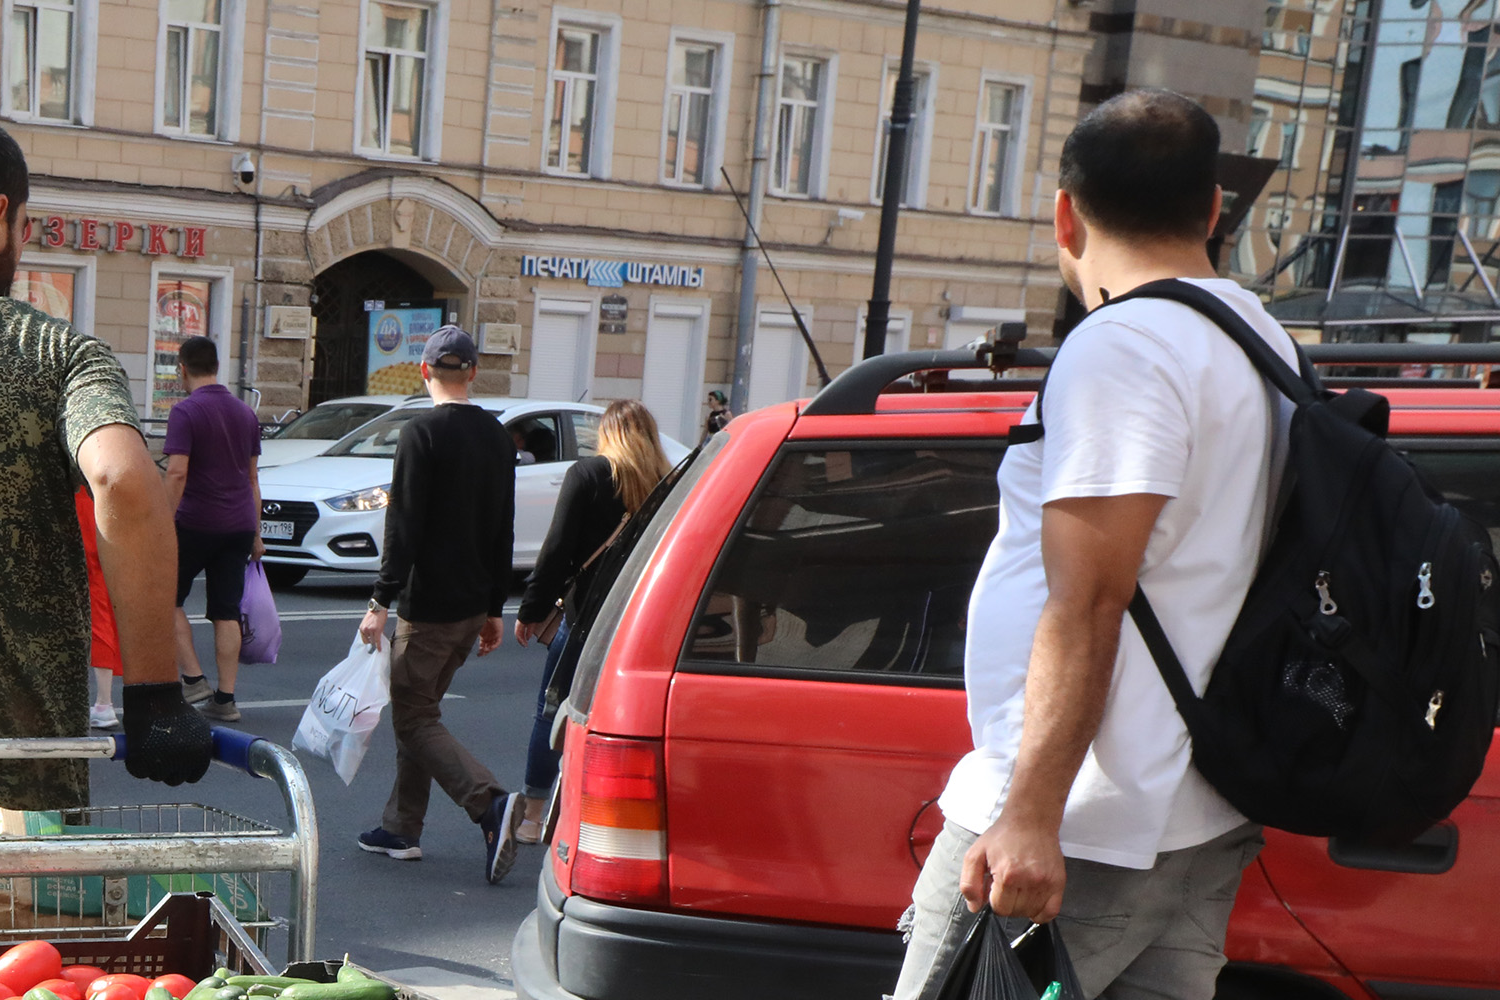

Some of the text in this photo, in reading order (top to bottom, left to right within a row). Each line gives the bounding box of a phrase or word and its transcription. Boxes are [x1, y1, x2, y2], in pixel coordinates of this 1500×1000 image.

[523, 255, 705, 287] ПЕЧАТИ ШТАМПЫ
[280, 522, 293, 532] 198
